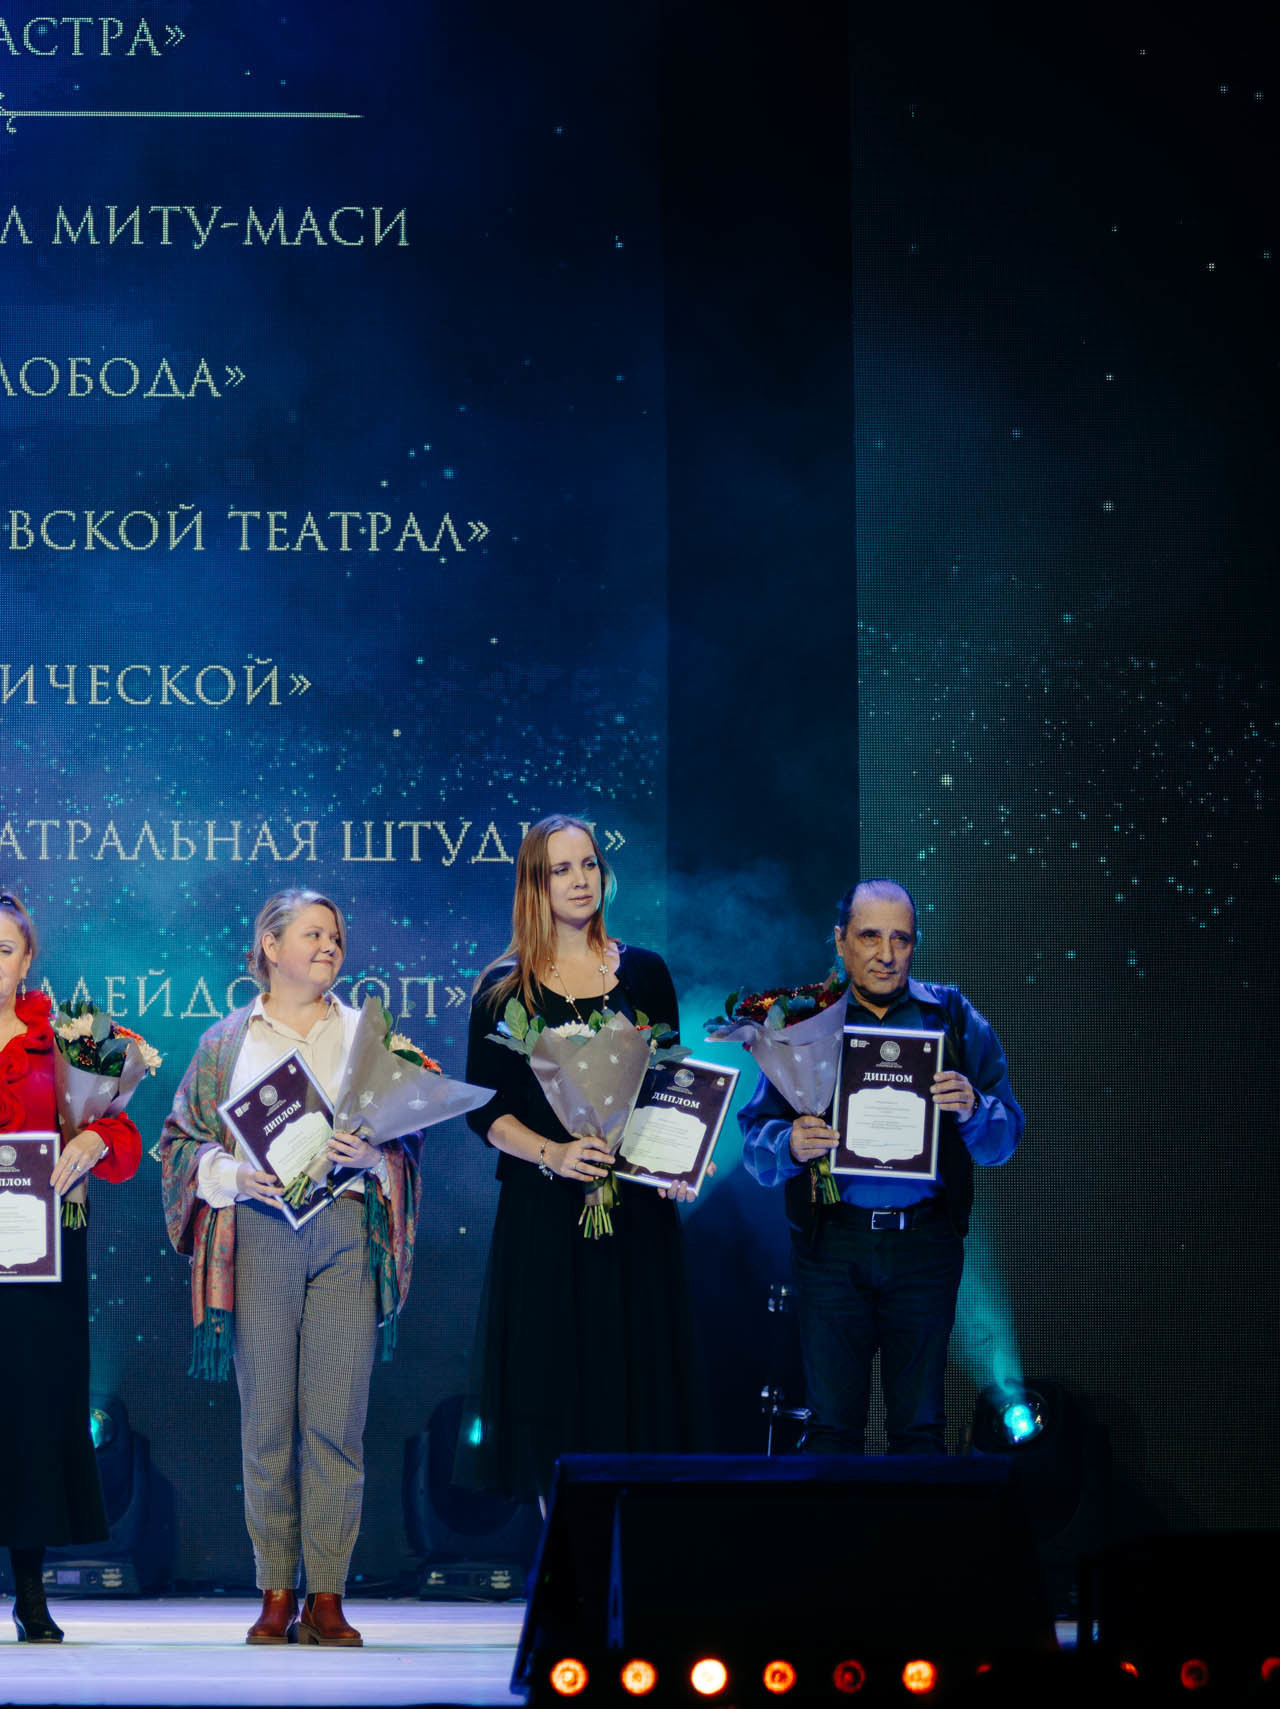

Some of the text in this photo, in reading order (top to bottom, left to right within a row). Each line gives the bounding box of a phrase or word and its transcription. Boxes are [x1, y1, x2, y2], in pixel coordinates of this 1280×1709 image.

[52, 205, 409, 249] МИТУ-МАСИ
[228, 510, 490, 553] ТЕАТРАЛ»
[342, 820, 626, 866] ШТУД»
[863, 1072, 913, 1083] ДИПЛОМ
[263, 1100, 302, 1136] ДИПЛОМ
[653, 1092, 701, 1109] ДИПЛОМ
